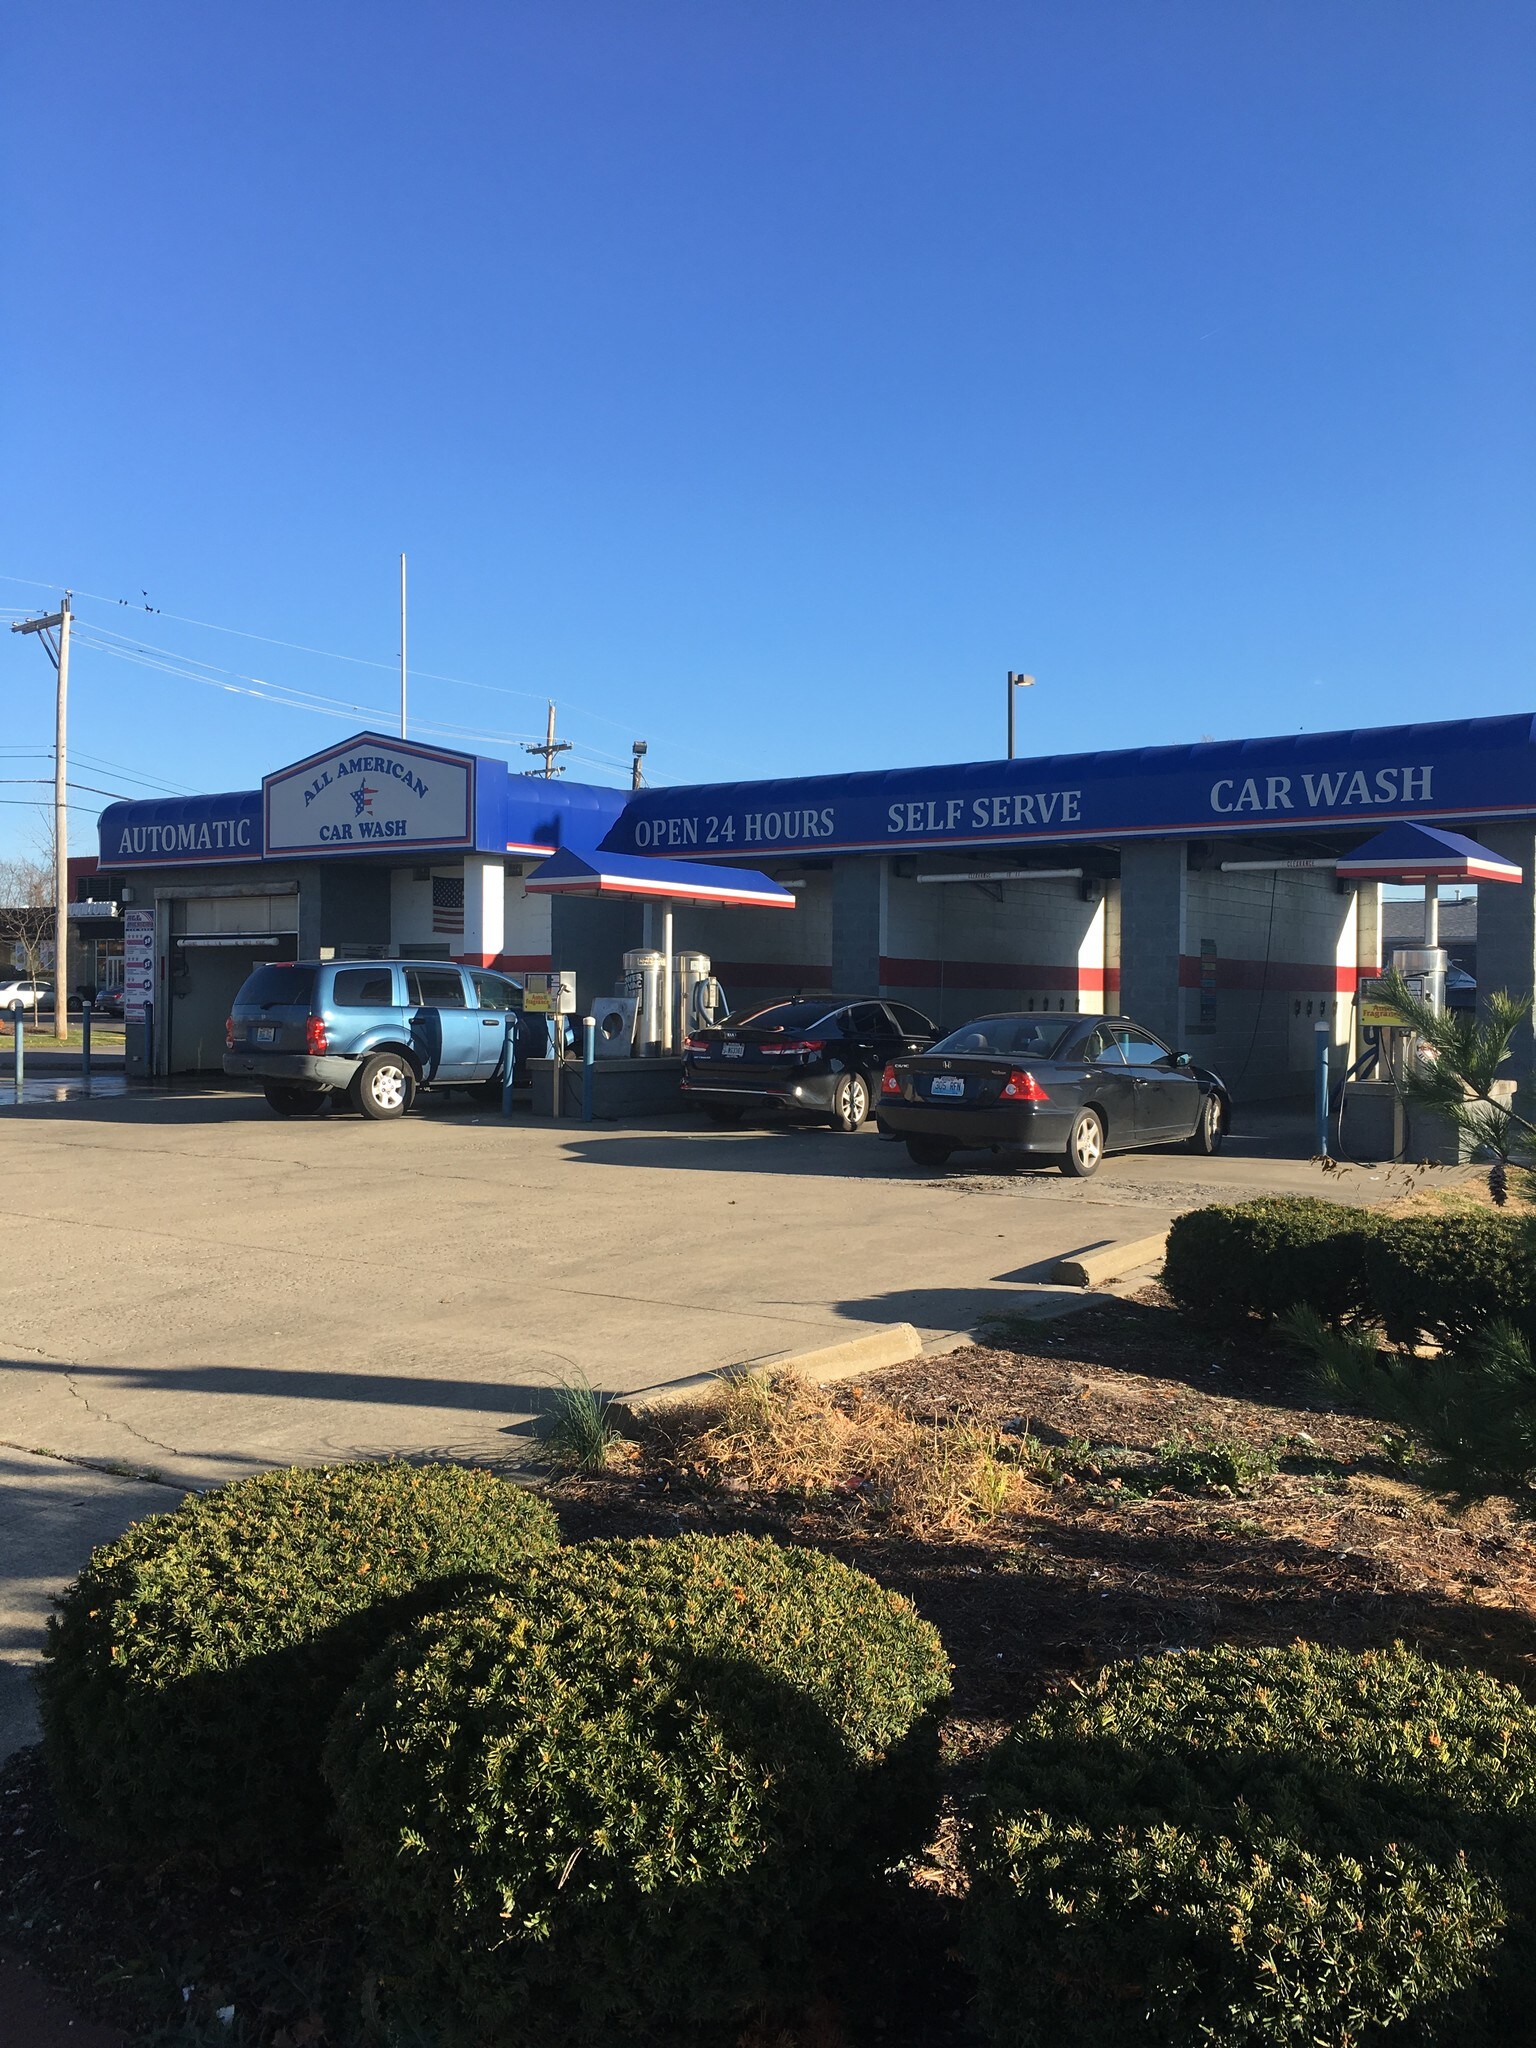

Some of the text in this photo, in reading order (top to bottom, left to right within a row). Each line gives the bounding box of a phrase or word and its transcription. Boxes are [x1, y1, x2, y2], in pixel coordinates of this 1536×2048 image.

[303, 756, 429, 808] ALL AMERICAN
[1210, 766, 1434, 813] CAR WASH
[319, 820, 407, 841] CAR WASH
[634, 808, 835, 847] OPEN 24 HOURS
[887, 790, 1081, 833] SELF SERVE
[118, 818, 251, 854] AUTOMATIC
